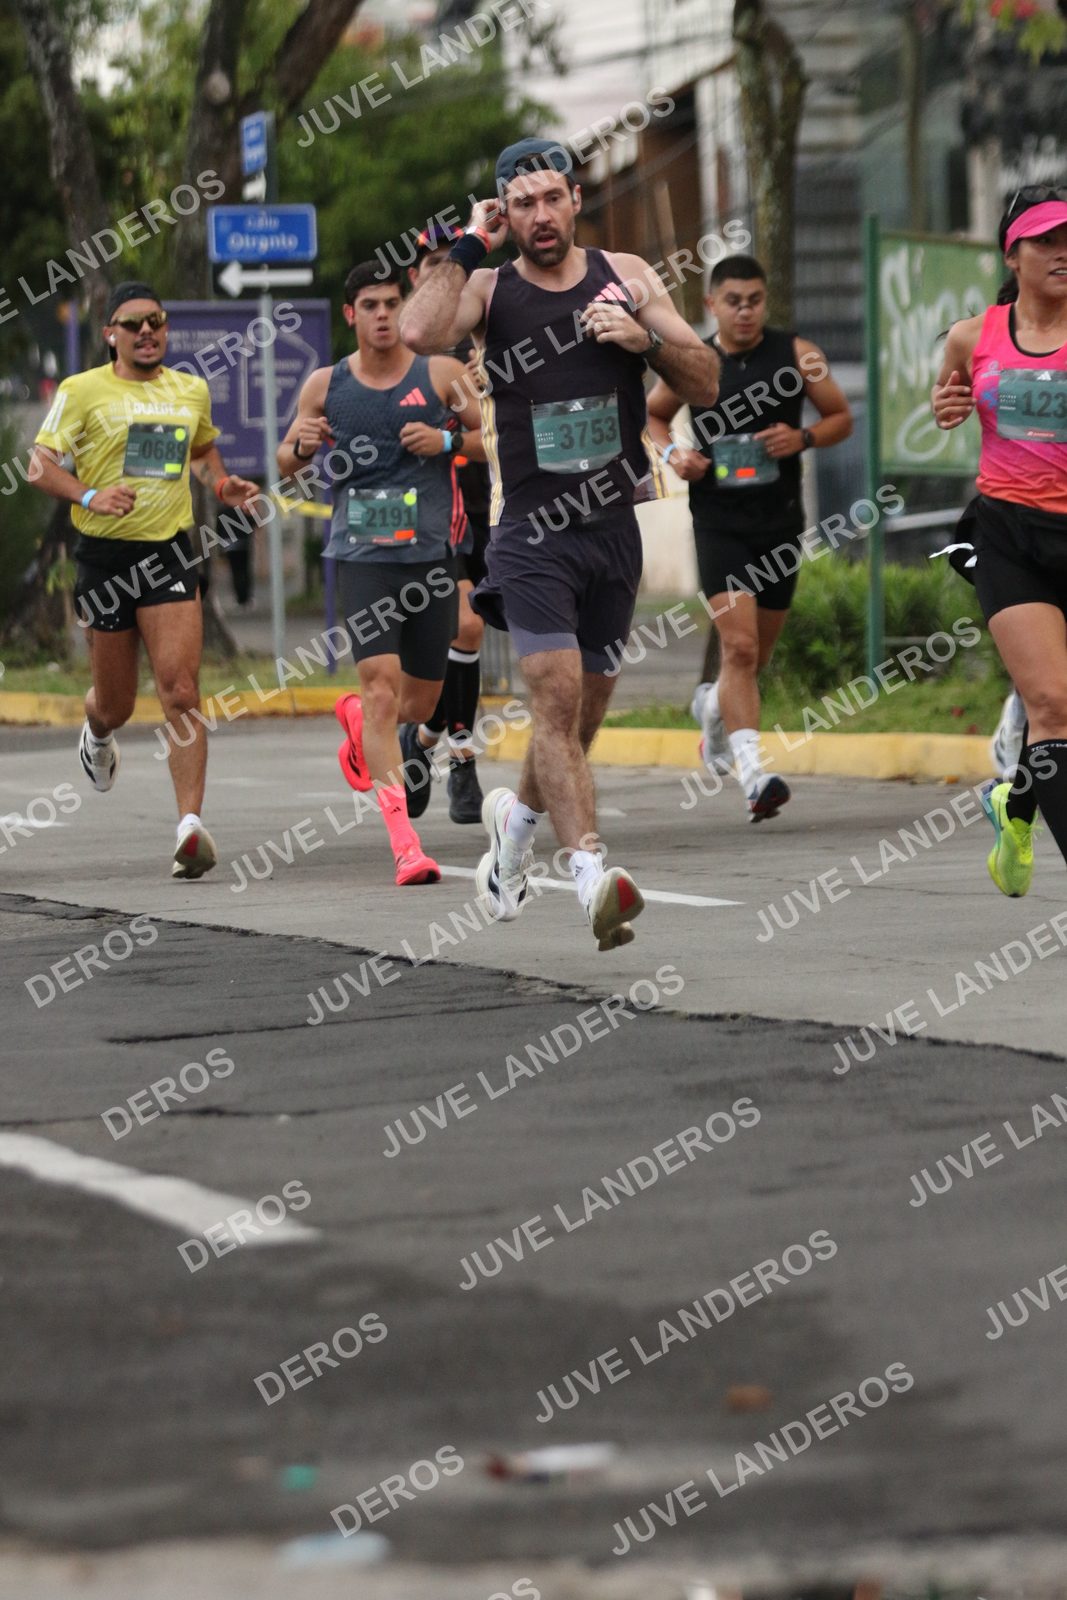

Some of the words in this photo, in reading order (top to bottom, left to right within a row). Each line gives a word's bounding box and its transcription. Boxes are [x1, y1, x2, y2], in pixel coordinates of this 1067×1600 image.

[1022, 390, 1067, 419] 123
[560, 415, 617, 450] 3753
[365, 506, 415, 528] 2191
